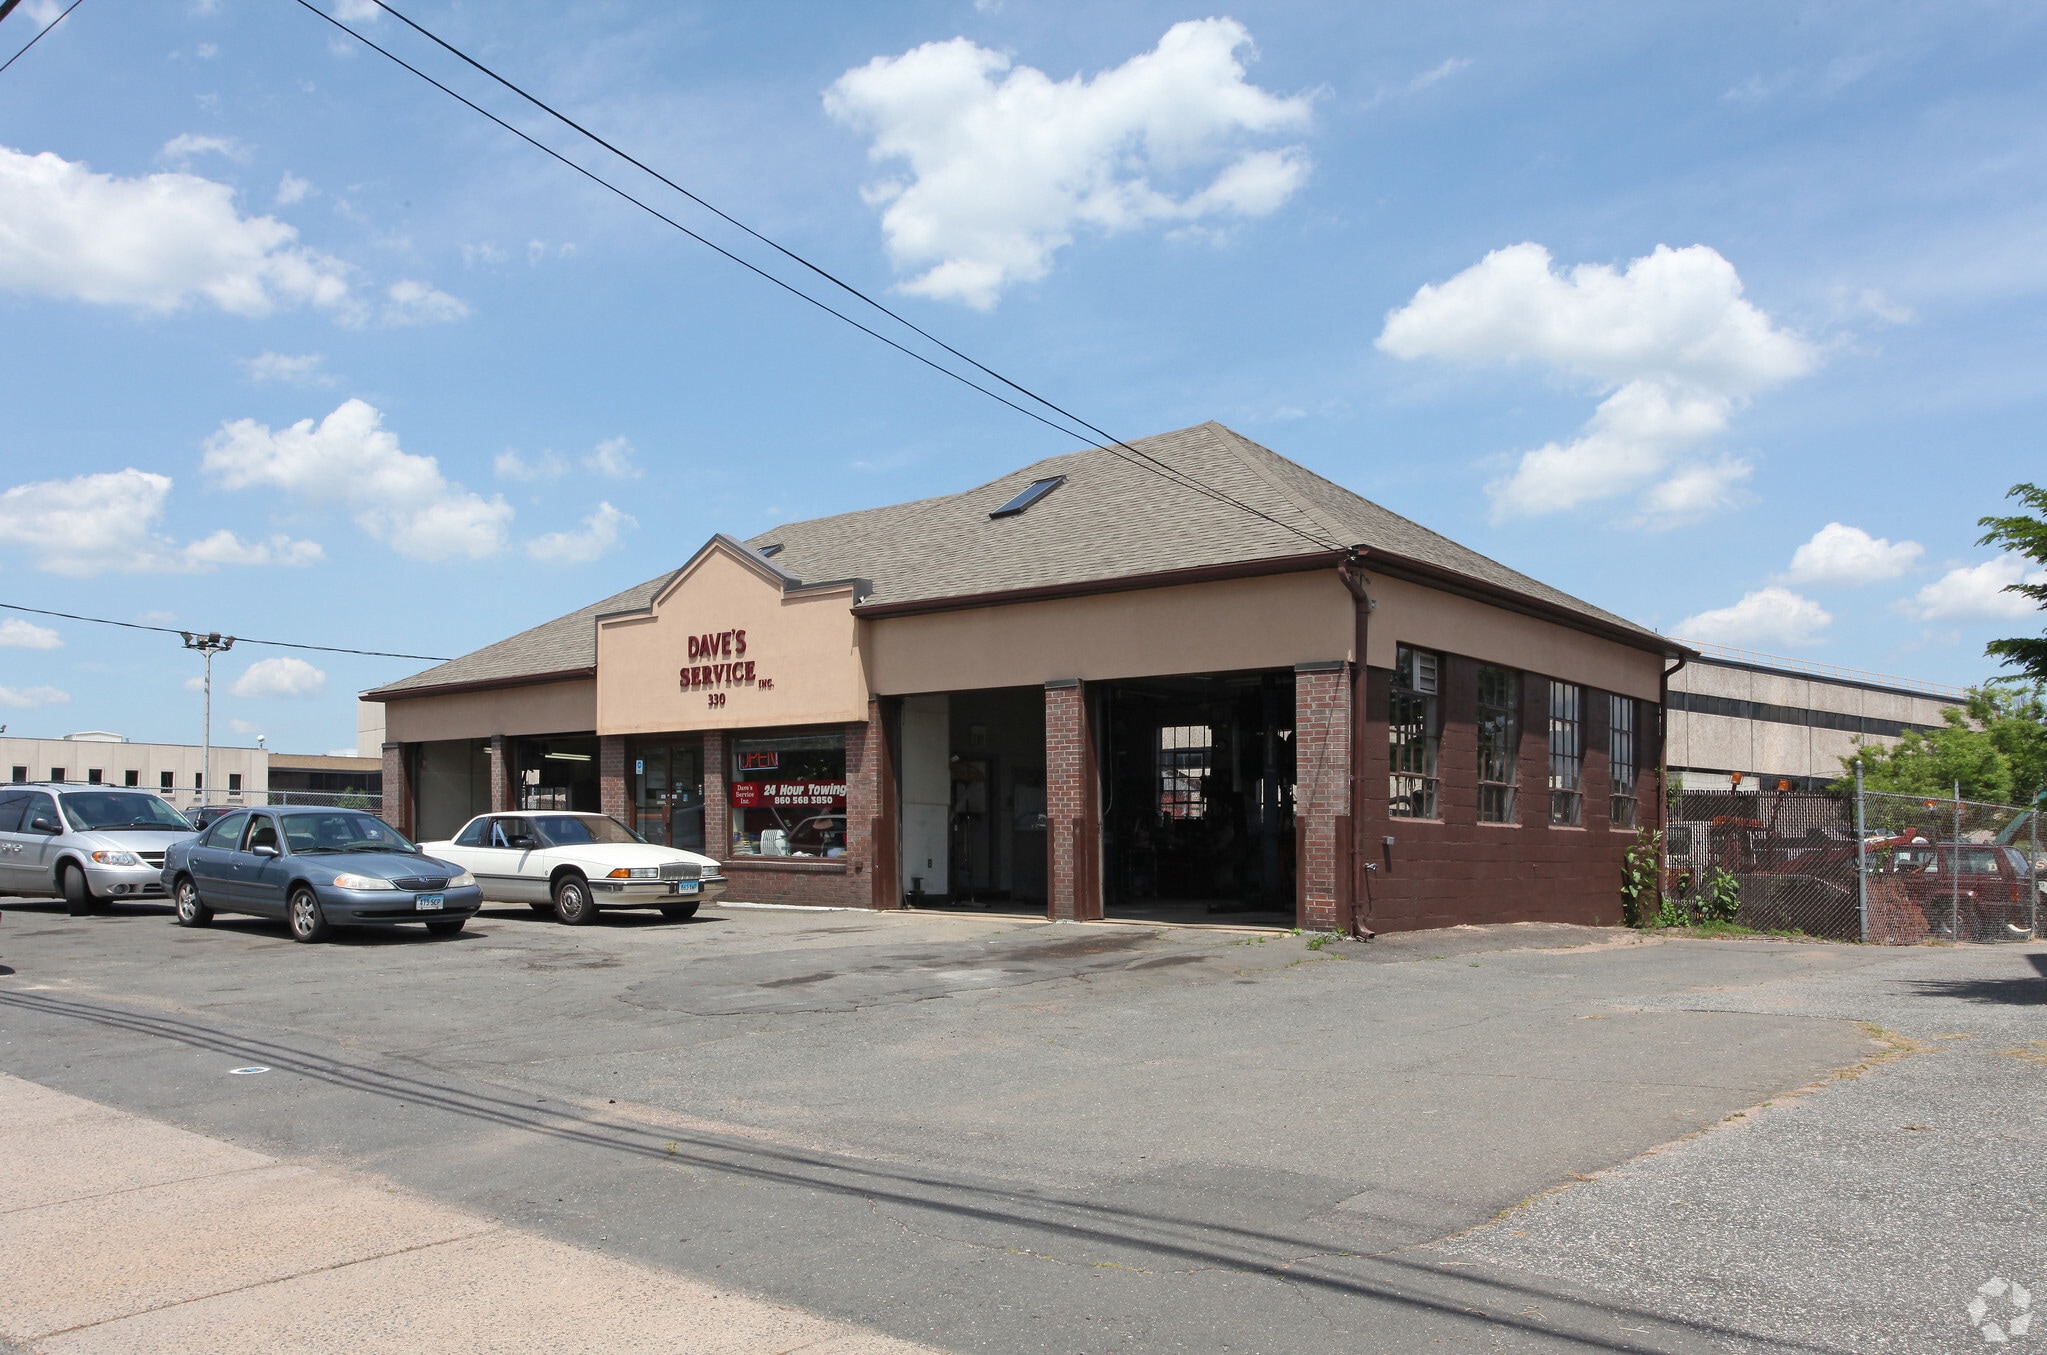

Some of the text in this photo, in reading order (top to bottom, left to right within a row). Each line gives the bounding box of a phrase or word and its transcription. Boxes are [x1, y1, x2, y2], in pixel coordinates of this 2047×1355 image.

[688, 629, 746, 658] DAVE'S
[680, 661, 756, 687] SERVICE
[708, 693, 725, 706] 330
[764, 783, 847, 797] 24 Hour Towing
[774, 796, 833, 804] 860 568 3850
